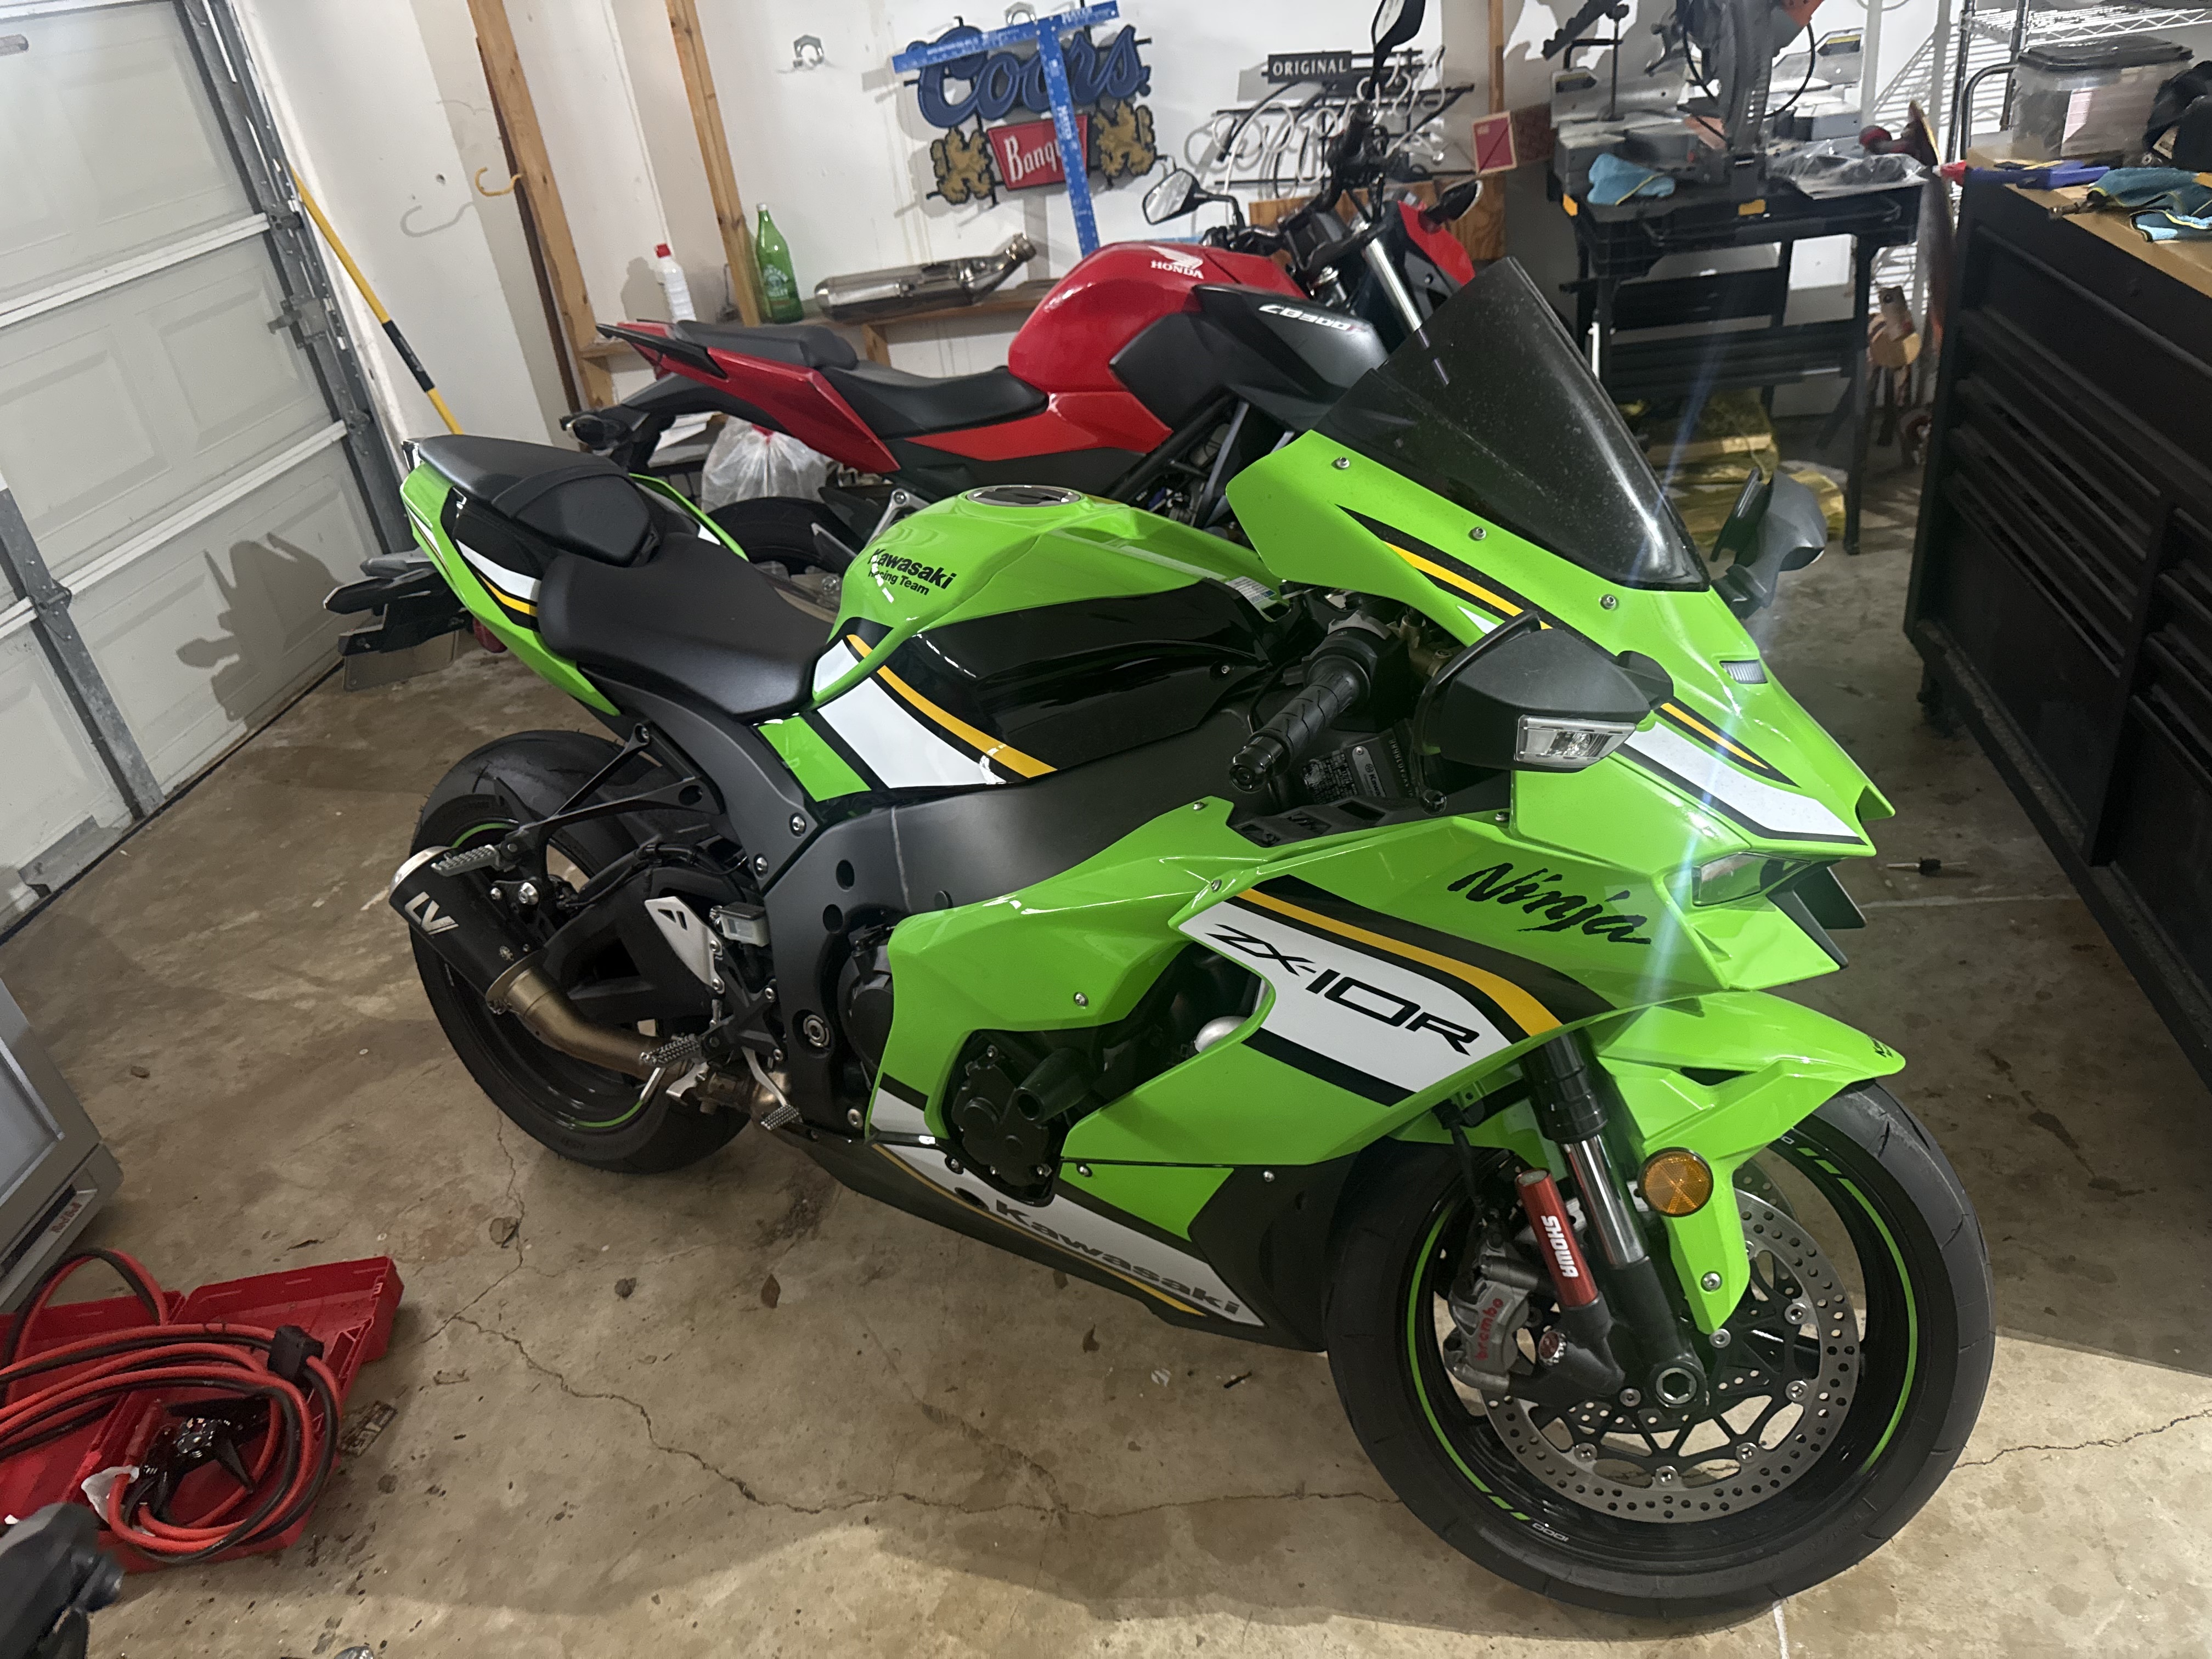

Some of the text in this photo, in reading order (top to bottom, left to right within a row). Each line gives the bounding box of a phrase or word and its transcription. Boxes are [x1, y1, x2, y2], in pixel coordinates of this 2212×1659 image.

[1272, 59, 1347, 76] ORIGINAL
[1003, 134, 1062, 182] Banq
[1150, 259, 1204, 278] HONDA
[867, 549, 957, 589] Kawasaki
[900, 575, 929, 595] Team
[405, 891, 459, 935] LV
[1447, 863, 1651, 944] Ninja
[1205, 924, 1480, 1056] ZX-10R
[995, 1200, 1240, 1314] Kawasaki
[1541, 1215, 1579, 1278] SHOWA
[1474, 1297, 1503, 1362] brembo
